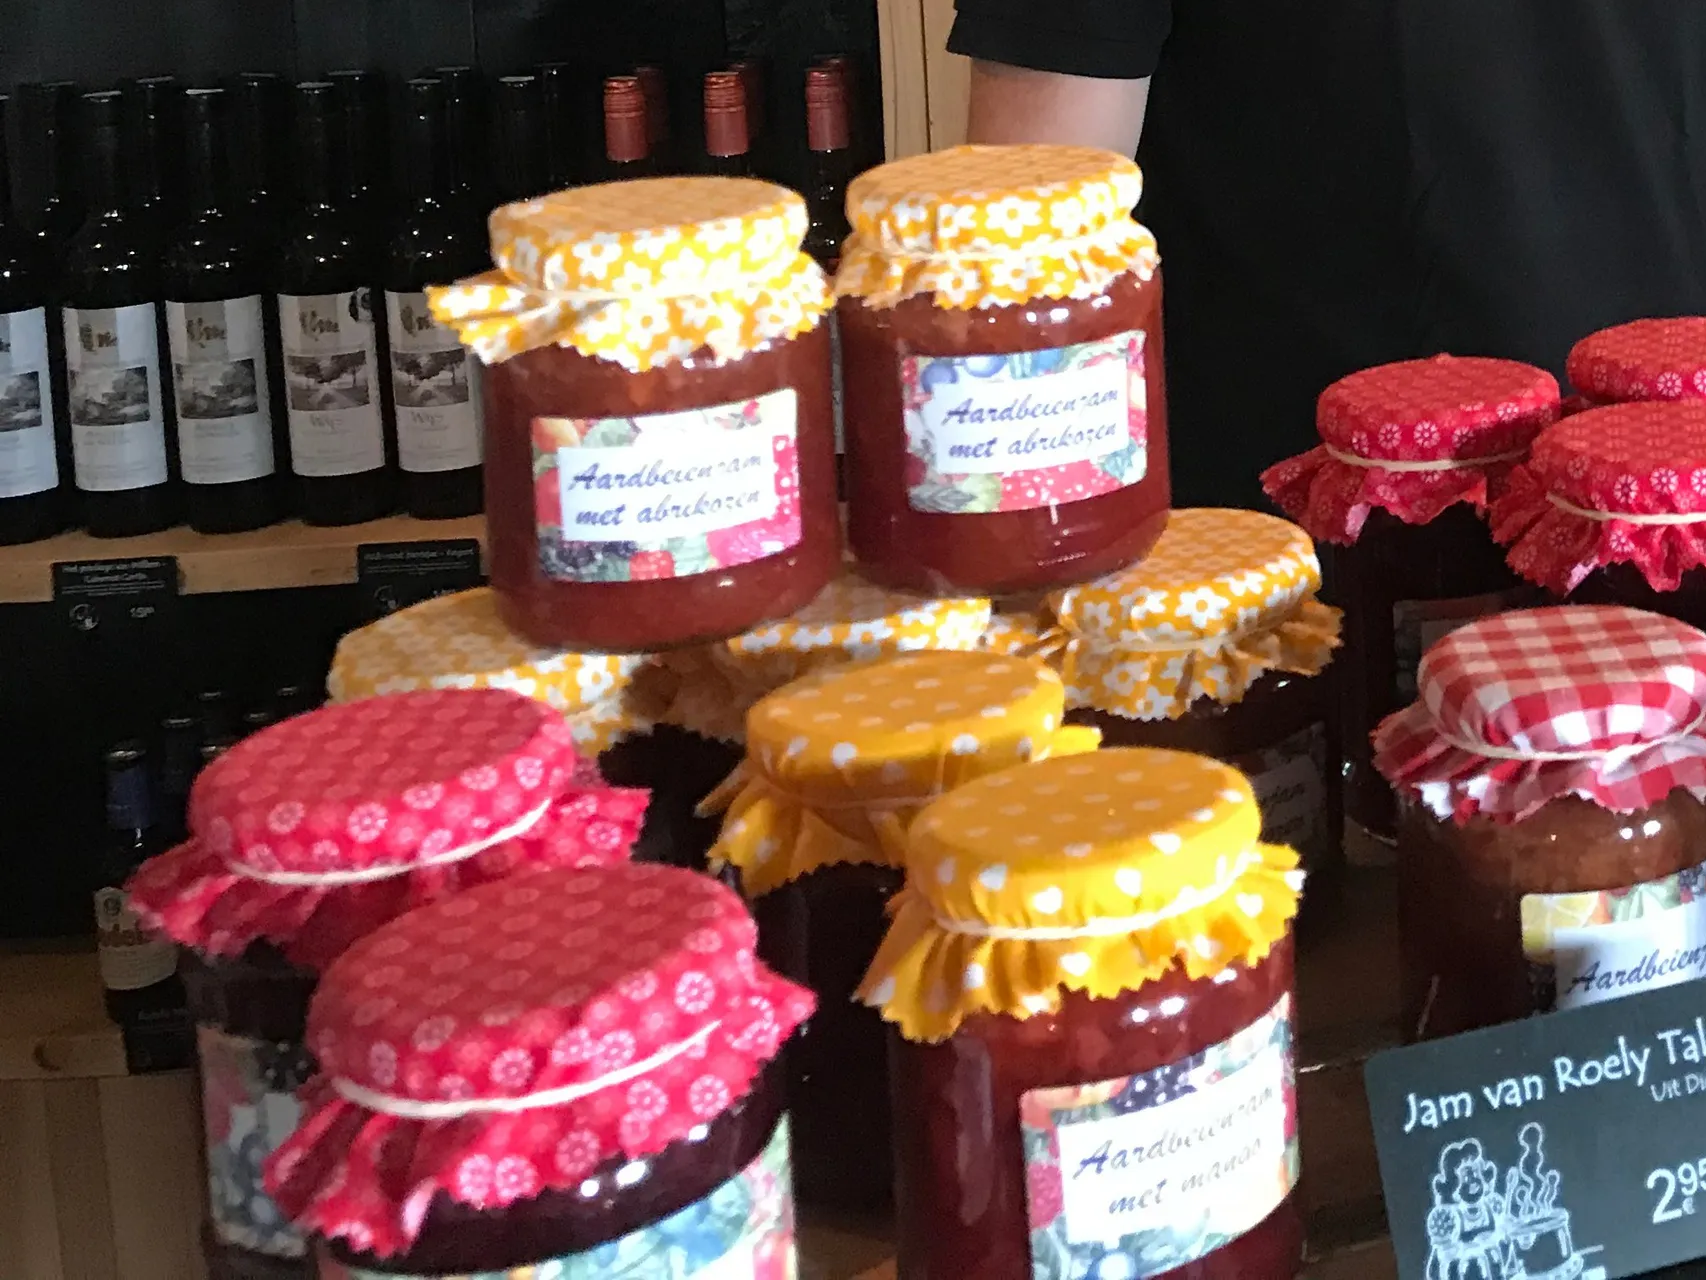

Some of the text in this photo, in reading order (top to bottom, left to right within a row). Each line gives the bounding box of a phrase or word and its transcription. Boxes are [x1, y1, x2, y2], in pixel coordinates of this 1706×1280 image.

[949, 422, 1116, 458] met abrikozen
[576, 490, 760, 526] met abrikozen
[1403, 1090, 1472, 1134] Jam
[1483, 1074, 1544, 1110] van
[1554, 1036, 1651, 1093] Roely
[1650, 1081, 1682, 1103] Uit
[1108, 1178, 1167, 1215] met
